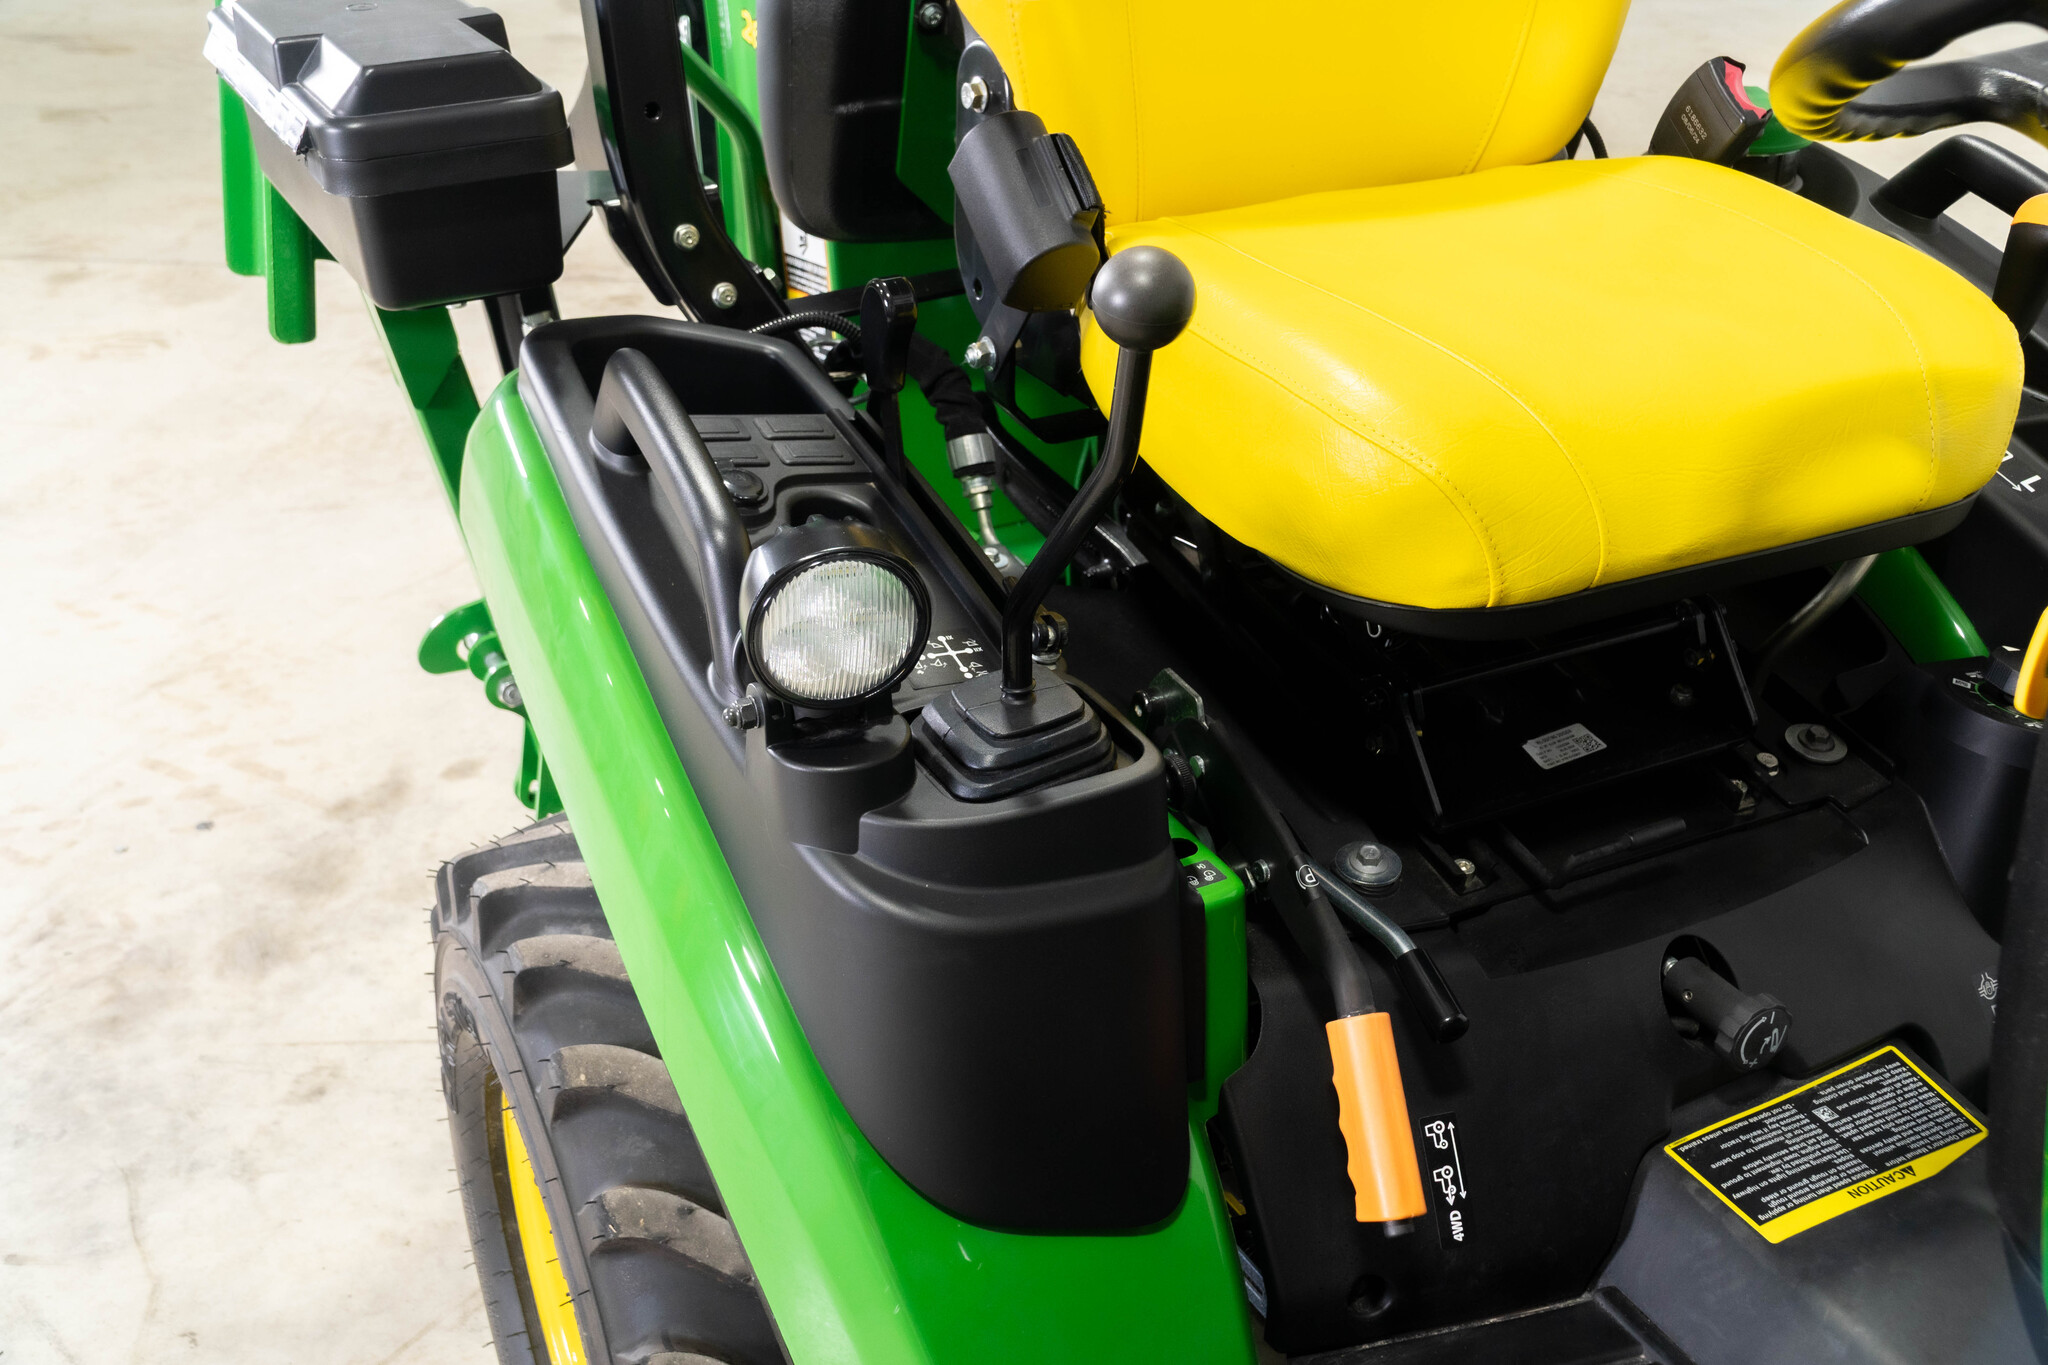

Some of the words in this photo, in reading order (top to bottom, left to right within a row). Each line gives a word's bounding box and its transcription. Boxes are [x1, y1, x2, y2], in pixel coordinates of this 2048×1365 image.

[1884, 1061, 1900, 1069] away
[1889, 1066, 1907, 1074] Keep
[1853, 1071, 1872, 1082] power
[1870, 1067, 1887, 1075] from
[1834, 1079, 1854, 1089] driven
[1900, 1076, 1918, 1084] Keep
[1902, 1079, 1922, 1091] engine
[1837, 1087, 1850, 1095] and
[1875, 1085, 1894, 1094] riders
[1903, 1090, 1918, 1098] clear
[1812, 1092, 1838, 1104] clothing
[1848, 1095, 1869, 1105] tractor
[1917, 1091, 1935, 1100] Make
[1923, 1096, 1940, 1105] hitch
[1835, 1102, 1848, 1111] and
[1870, 1098, 1896, 1111] machine
[1896, 1097, 1918, 1108] certain
[1908, 1101, 1924, 1111] plate
[1928, 1101, 1946, 1110] Hitch
[1747, 1111, 1771, 1122] operate
[1851, 1108, 1873, 1118] before
[1872, 1105, 1898, 1117] children
[1884, 1111, 1902, 1121] avoid
[1910, 1108, 1930, 1118] towed
[1927, 1108, 1944, 1118] place
[1778, 1113, 1805, 1125] Remove
[1780, 1116, 1810, 1131] servicing
[1827, 1116, 1852, 1128] starting
[1854, 1114, 1874, 1125] and/or
[1858, 1117, 1885, 1131] rearward
[1894, 1115, 1912, 1124] loads
[1722, 1120, 1748, 1132] machine
[1801, 1123, 1817, 1131] Wait
[1833, 1122, 1854, 1133] others
[1880, 1121, 1895, 1129] only
[1912, 1121, 1935, 1131] shields
[1919, 1124, 1943, 1136] operate
[1939, 1120, 1968, 1136] operating
[1701, 1130, 1723, 1141] unless
[1738, 1129, 1764, 1140] leaving
[1815, 1132, 1829, 1141] and
[1851, 1133, 1864, 1141] rear
[1900, 1129, 1913, 1137] and
[1957, 1127, 1975, 1137] Read
[1719, 1137, 1741, 1149] tractor
[1752, 1135, 1785, 1151] movement
[1819, 1137, 1836, 1146] Stop
[1882, 1134, 1901, 1144] safety
[1894, 1134, 1921, 1146] machine
[1926, 1134, 1959, 1149] Operator's
[1788, 1141, 1807, 1151] brake
[1820, 1142, 1842, 1153] unless
[1859, 1141, 1883, 1153] devices
[1872, 1144, 1896, 1156] without
[1730, 1150, 1746, 1159] stop
[1761, 1148, 1789, 1162] securely
[1782, 1152, 1800, 1161] lower
[1789, 1150, 1821, 1166] prohibited
[1808, 1152, 1837, 1165] flashing
[1904, 1147, 1928, 1159] Manual
[1710, 1156, 1732, 1168] before
[1741, 1159, 1764, 1170] before
[1836, 1158, 1862, 1170] hazards
[1884, 1155, 1906, 1166] before
[1749, 1158, 1783, 1175] implement
[1784, 1162, 1811, 1175] warning
[1845, 1163, 1869, 1174] brakes
[1767, 1172, 1787, 1183] lights
[1808, 1171, 1828, 1181] rough
[1850, 1168, 1875, 1180] Reduce
[1720, 1174, 1744, 1189] ground
[1786, 1177, 1809, 1191] ground
[1807, 1174, 1839, 1189] operating
[1831, 1177, 1851, 1188] speed
[1846, 1170, 1906, 1199] CAUTION
[1731, 1184, 1760, 1199] highway
[1786, 1186, 1810, 1200] around
[1814, 1185, 1833, 1195] when
[1760, 1191, 1779, 1202] steep
[1767, 1196, 1788, 1207] rough
[1791, 1192, 1817, 1204] turning
[1757, 1205, 1786, 1220] applying
[1450, 1210, 1464, 1241] 4WD
